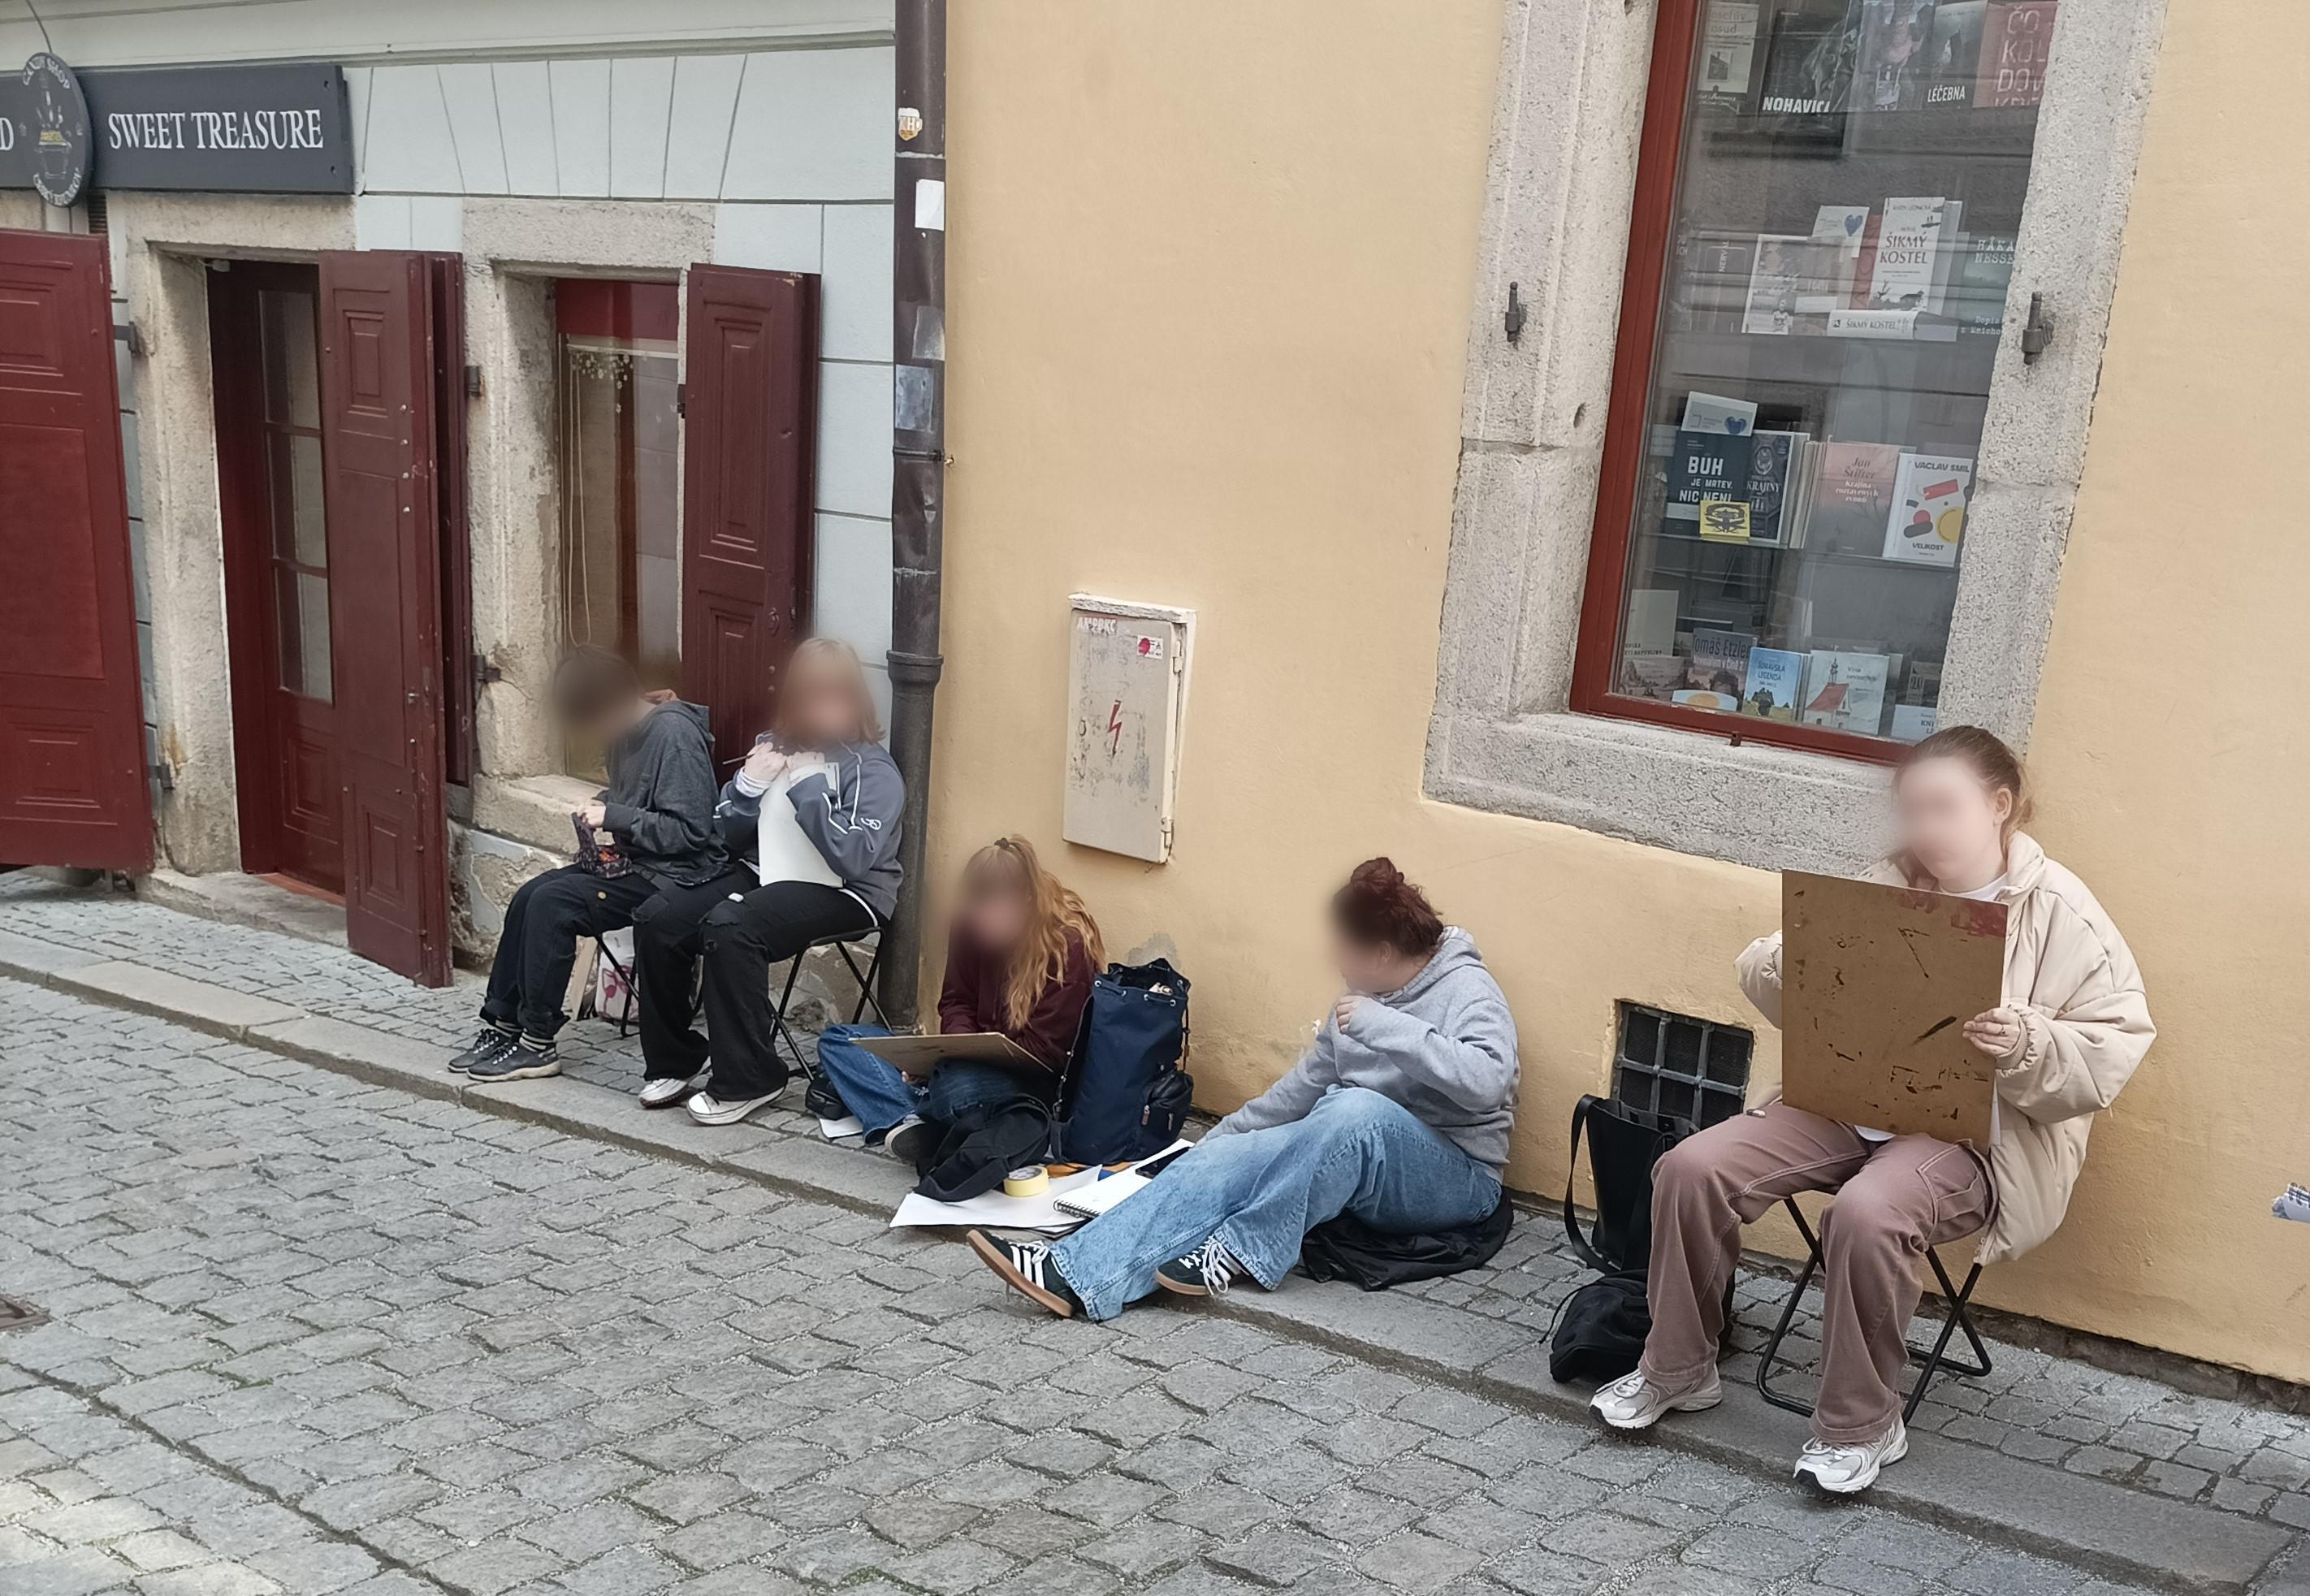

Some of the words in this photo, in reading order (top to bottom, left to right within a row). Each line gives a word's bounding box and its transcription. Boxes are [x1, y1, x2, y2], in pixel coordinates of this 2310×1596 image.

[1927, 84, 1966, 103] LÉČEBNA
[108, 112, 186, 149] SWEET
[190, 110, 324, 149] TREASURE
[1885, 231, 1928, 249] ŠIKMÝ
[1880, 250, 1928, 264] KOSTEL
[1852, 457, 1871, 468] Jan
[1950, 465, 1970, 473] SMIL
[1691, 478, 1701, 487] JE
[1679, 489, 1699, 503] NIC
[1912, 543, 1945, 551] VELIKOST
